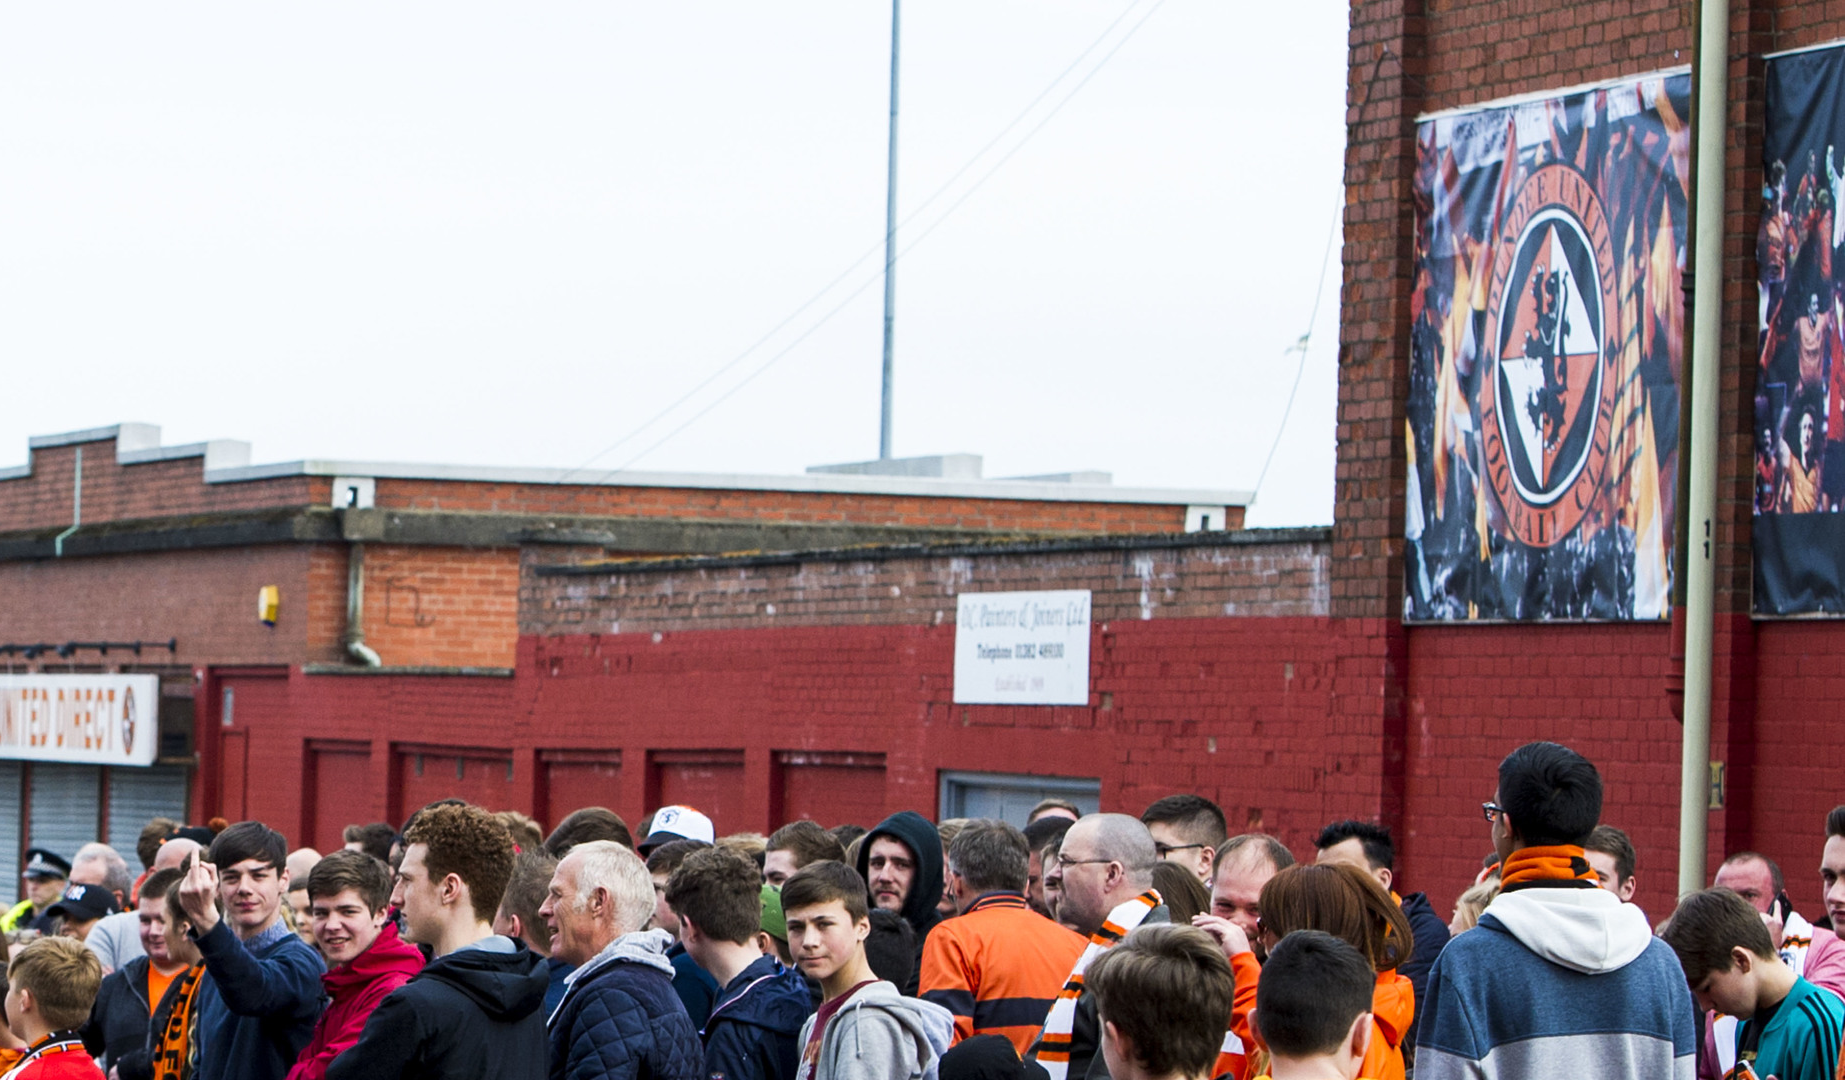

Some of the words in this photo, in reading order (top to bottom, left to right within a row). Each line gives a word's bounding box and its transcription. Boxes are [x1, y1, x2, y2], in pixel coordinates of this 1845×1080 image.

[1560, 168, 1615, 296] UNITED
[1482, 406, 1563, 543] FOOTBALL
[56, 688, 116, 751] DIRECT
